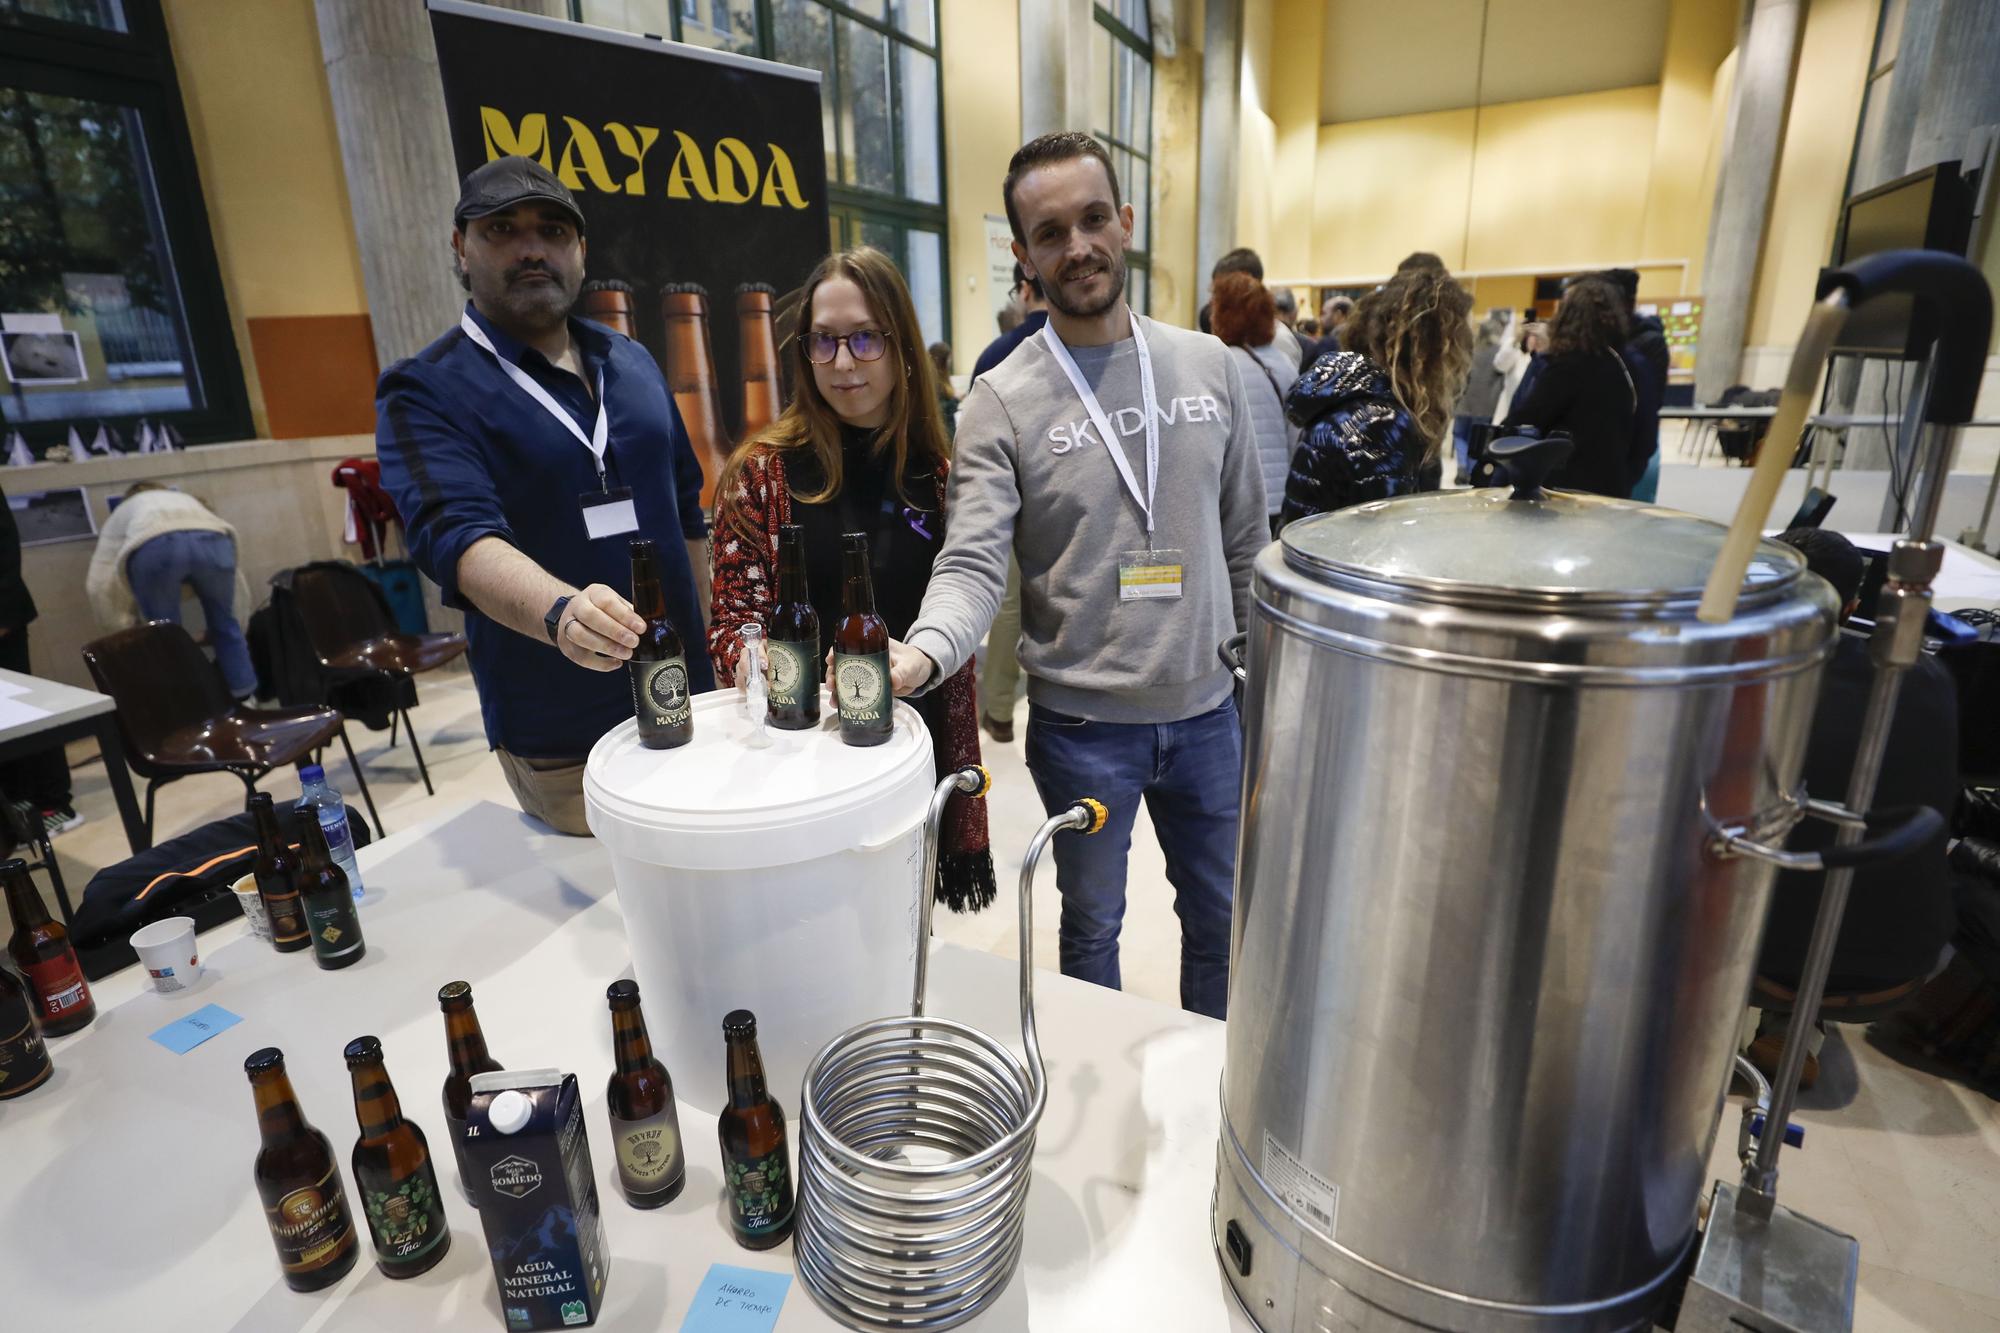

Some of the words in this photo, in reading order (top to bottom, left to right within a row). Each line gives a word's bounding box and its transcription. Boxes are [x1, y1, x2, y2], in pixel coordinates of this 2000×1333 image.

[480, 106, 810, 210] MAYADA
[1047, 395, 1222, 455] SKDVER
[840, 708, 880, 721] MAYADA
[492, 1173, 543, 1187] SOMIEDO
[515, 1261, 555, 1274] AGUA
[503, 1271, 572, 1286] MINERAL
[506, 1282, 575, 1299] NATURAL
